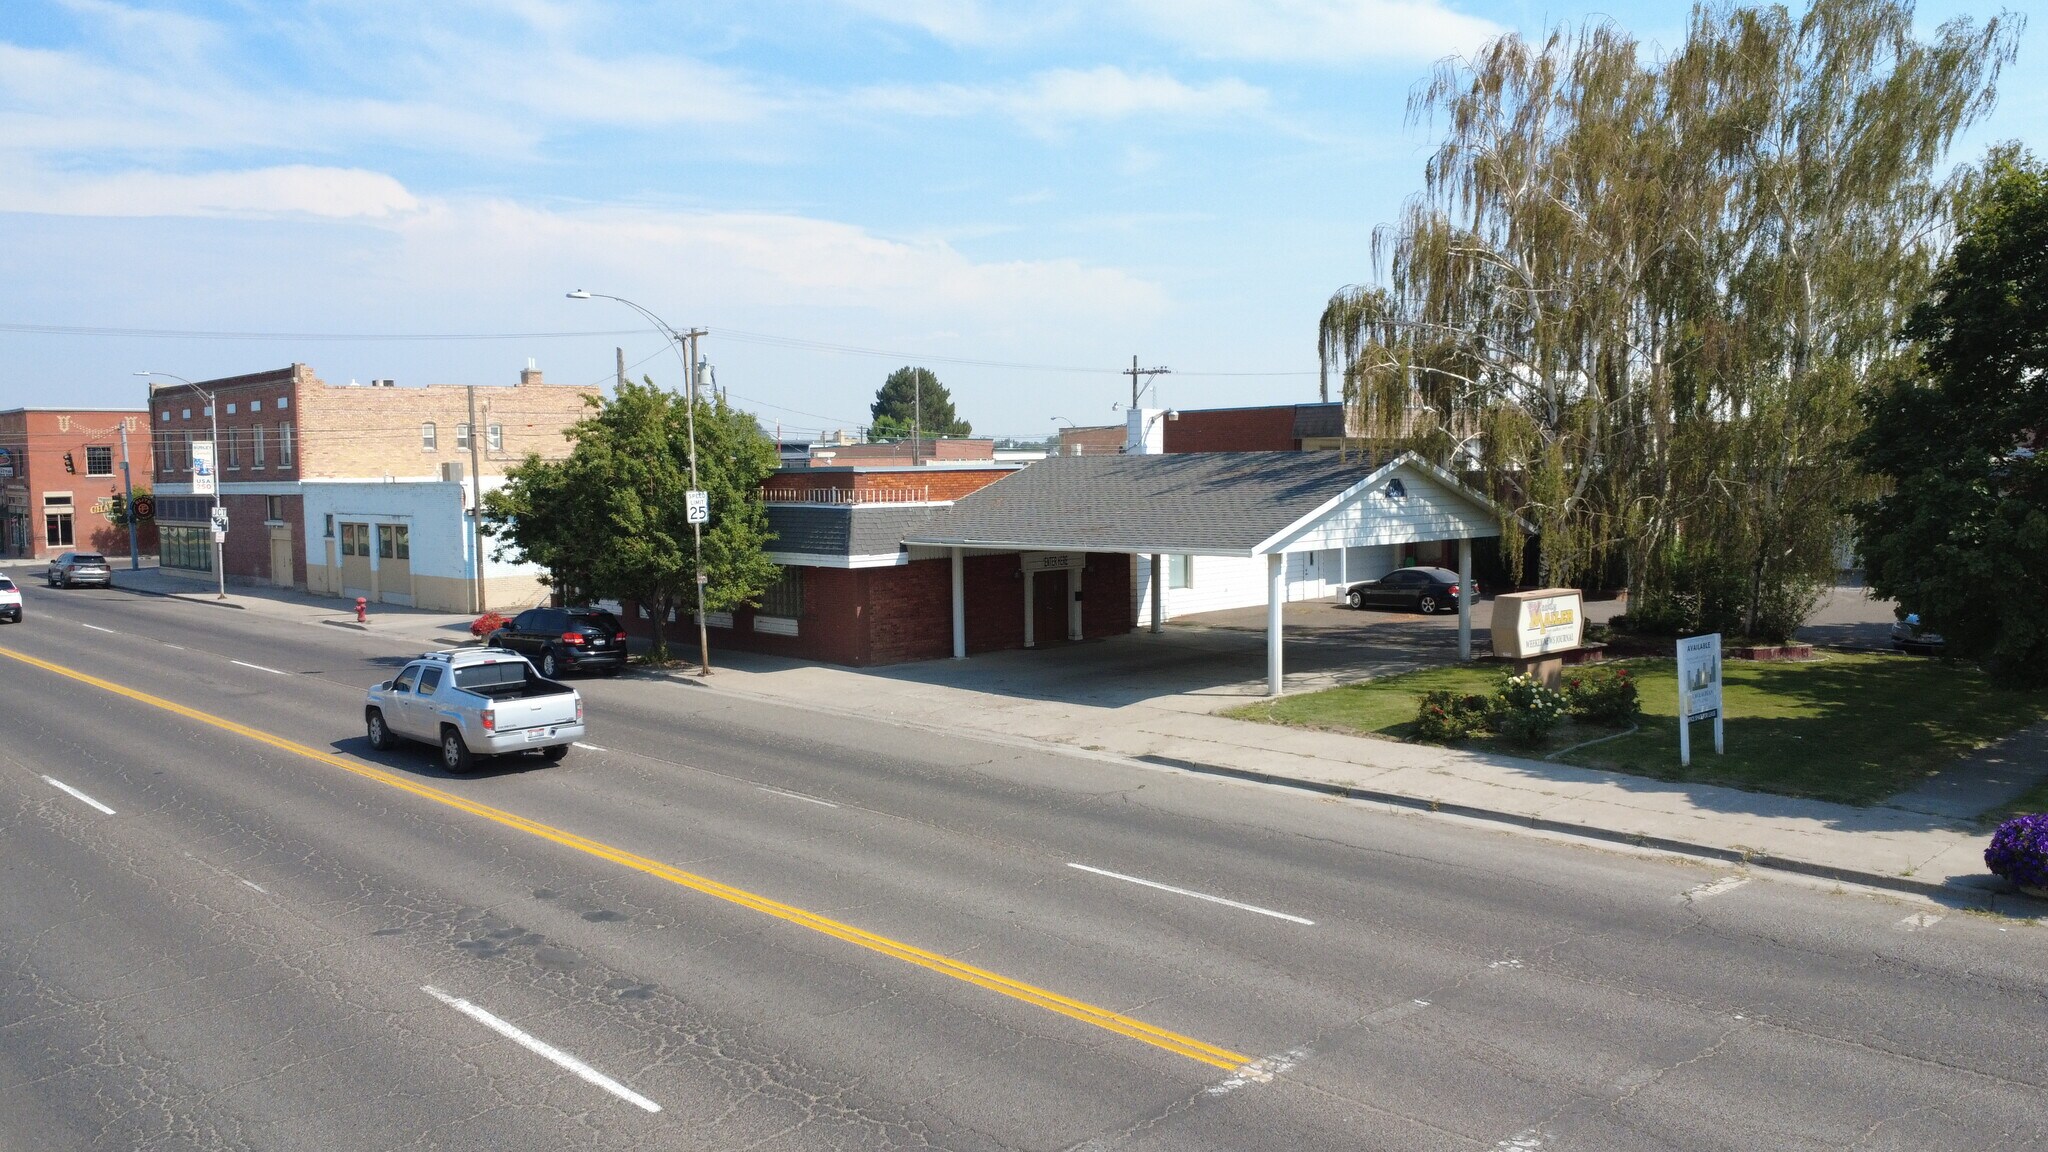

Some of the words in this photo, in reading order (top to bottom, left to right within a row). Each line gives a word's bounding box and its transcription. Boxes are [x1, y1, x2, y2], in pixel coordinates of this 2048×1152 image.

[212, 508, 226, 516] JCT
[690, 506, 706, 520] 25
[215, 517, 227, 526] 27
[1044, 556, 1057, 567] ENTER
[1057, 555, 1068, 565] HERE
[1687, 641, 1711, 652] AVAILABLE
